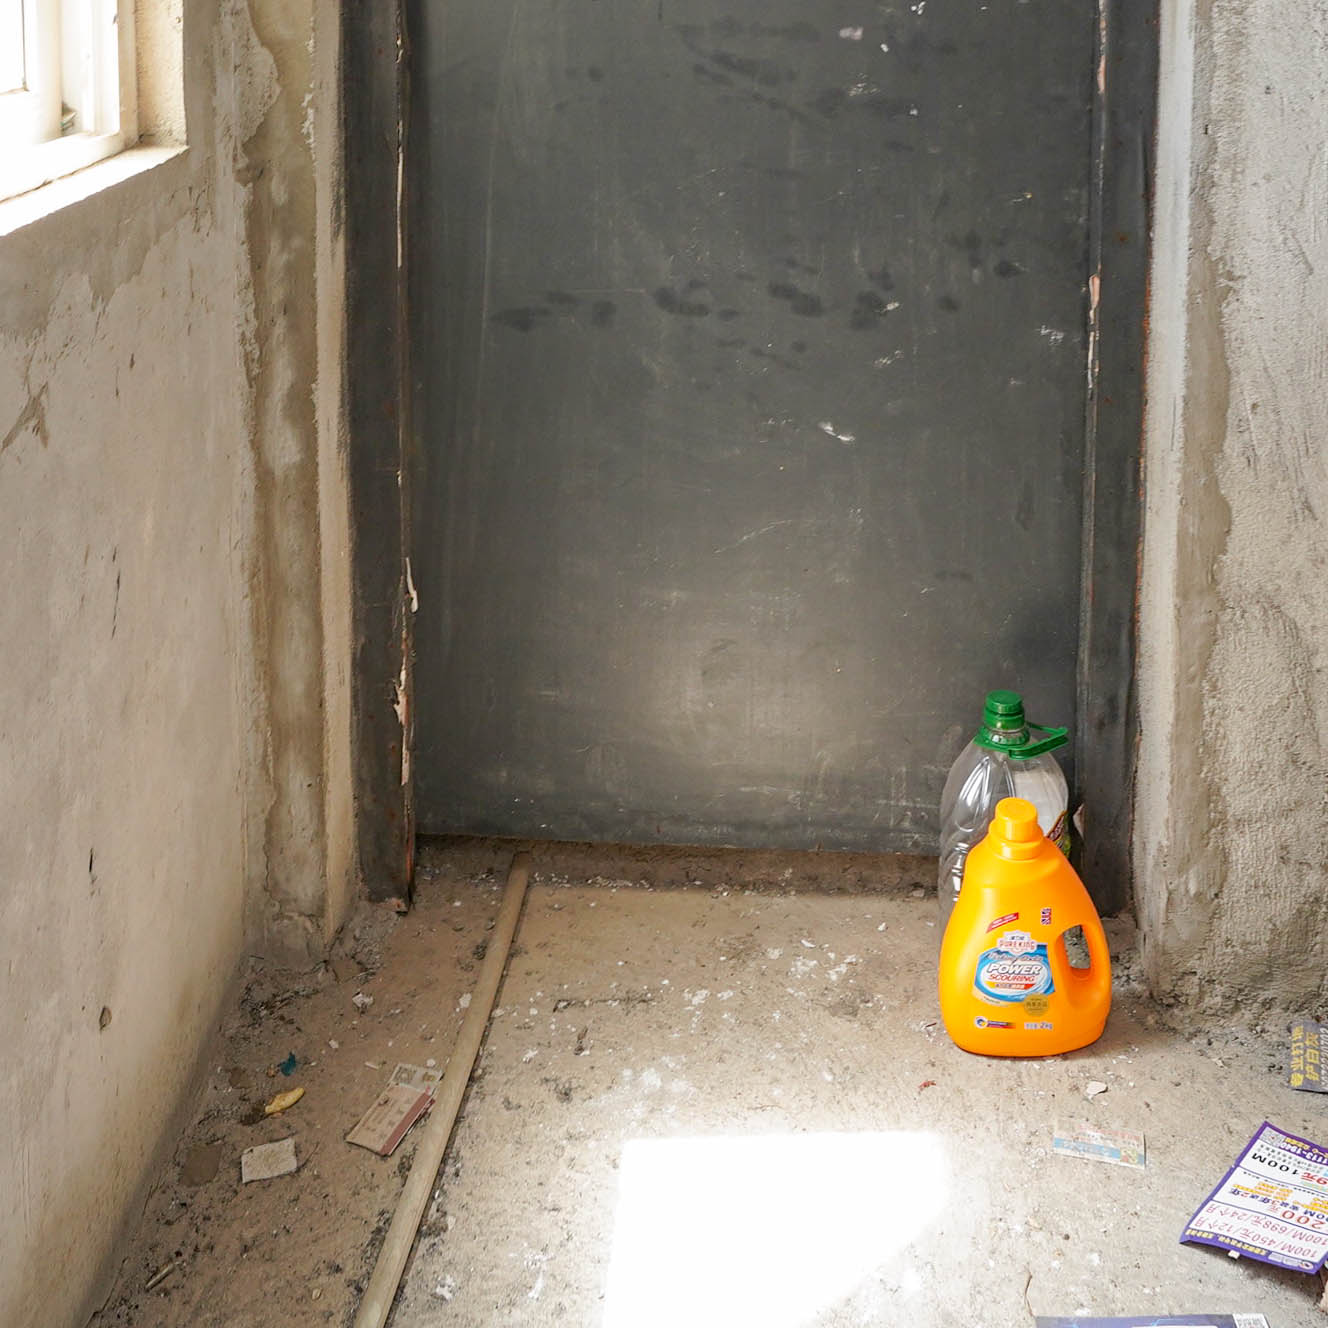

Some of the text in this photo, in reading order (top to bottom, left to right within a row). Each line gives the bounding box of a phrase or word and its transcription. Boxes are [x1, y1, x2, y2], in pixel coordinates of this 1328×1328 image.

[986, 962, 1043, 976] POWER
[989, 973, 1035, 982] SCOURING
[1252, 1152, 1299, 1175] 100M
